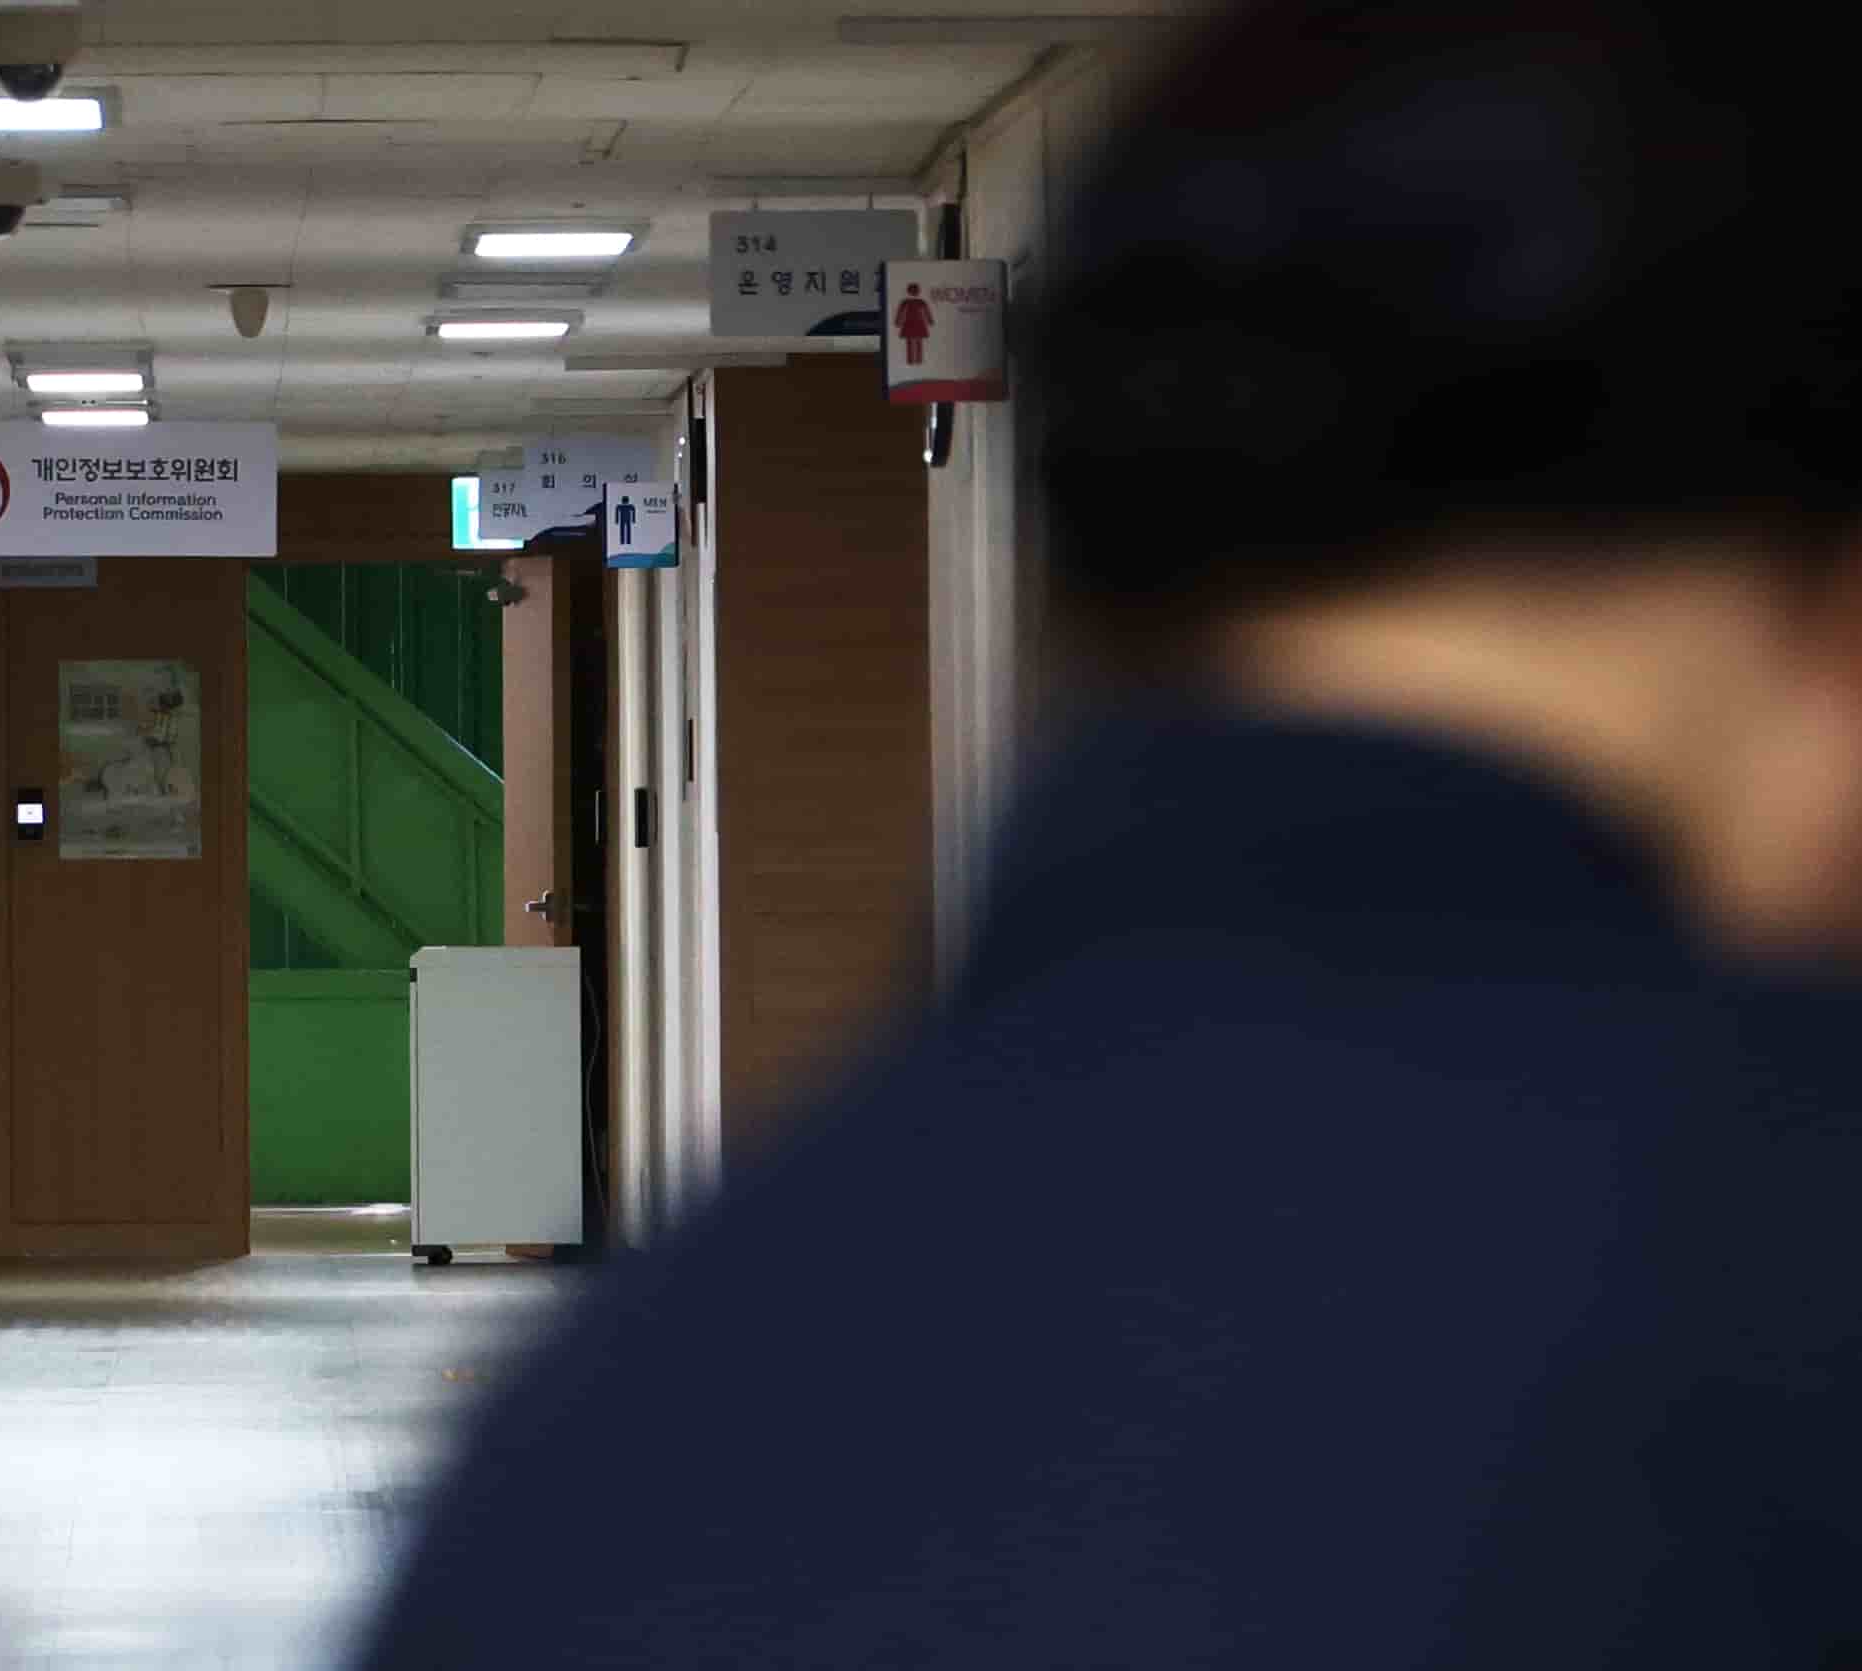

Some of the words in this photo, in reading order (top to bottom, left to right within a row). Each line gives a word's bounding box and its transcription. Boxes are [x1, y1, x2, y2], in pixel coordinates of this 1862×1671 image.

[735, 235, 778, 255] 314
[31, 457, 240, 483] 개인정보보호위원회
[492, 482, 516, 494] 317
[55, 492, 122, 506] Personal
[126, 492, 216, 506] Information
[43, 506, 124, 521] Protection
[130, 506, 223, 521] Commission
